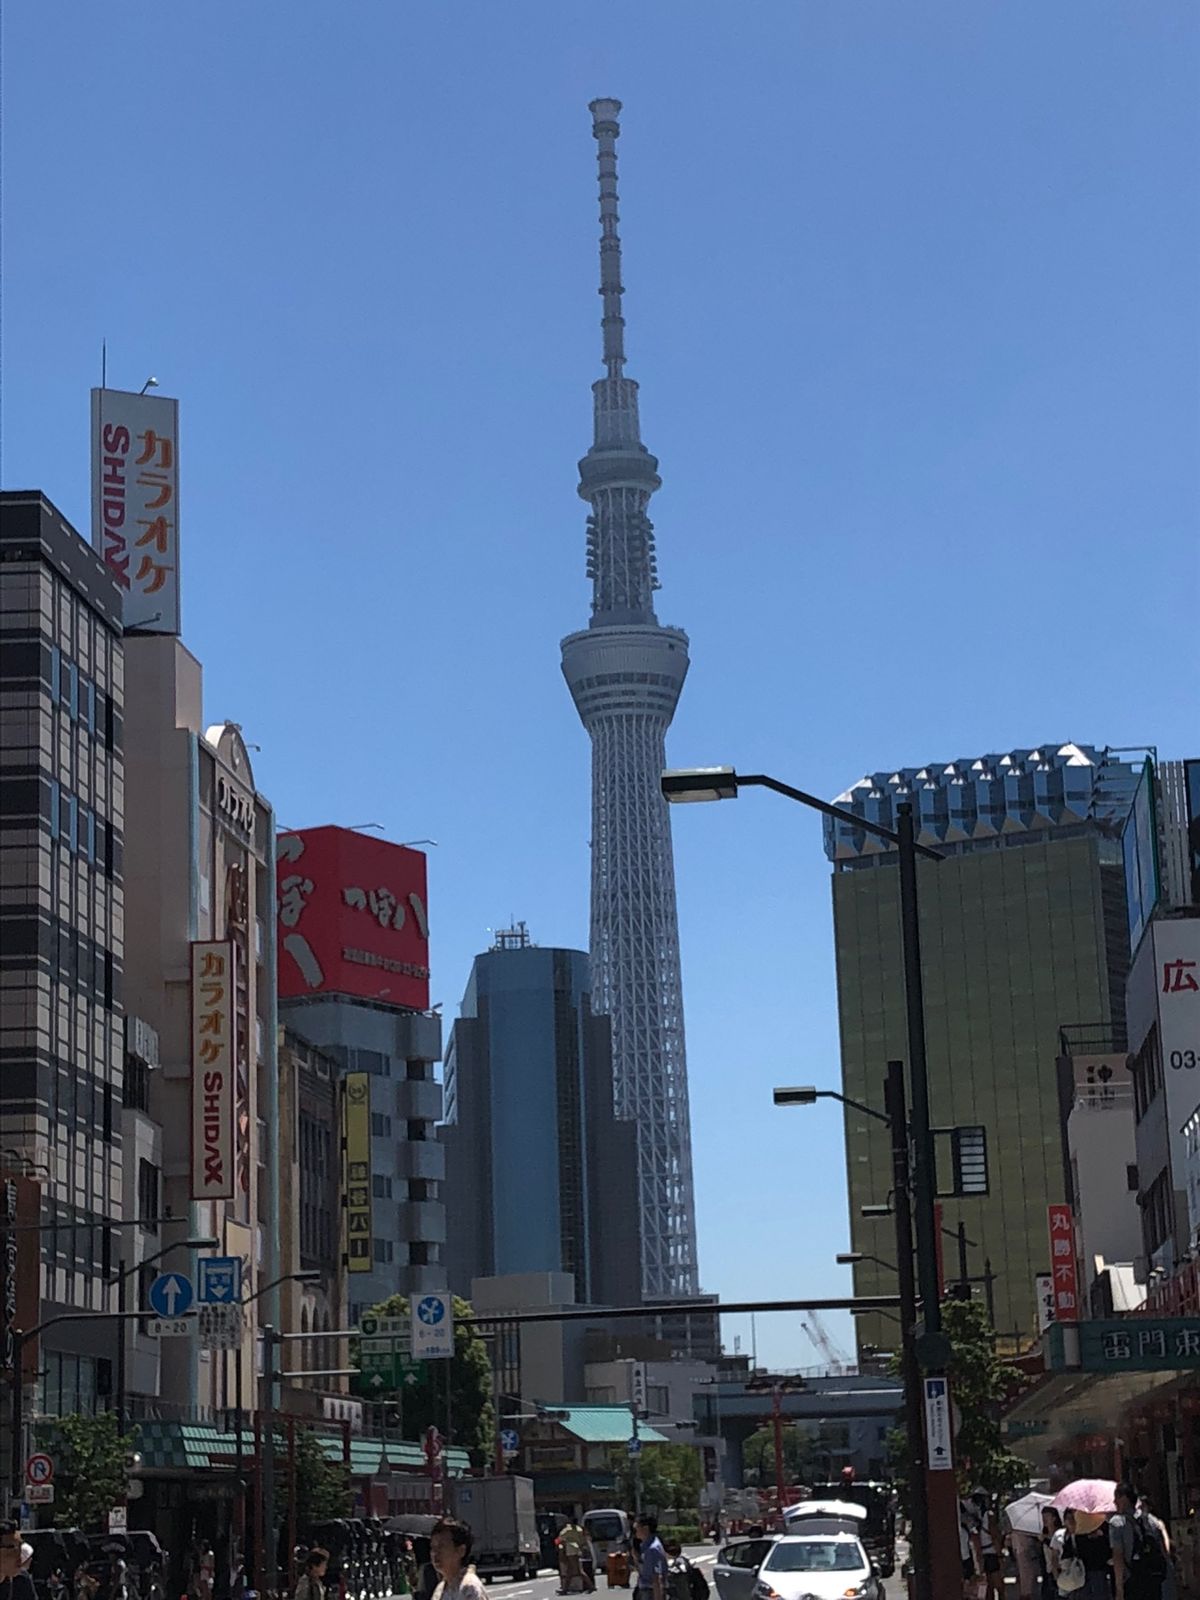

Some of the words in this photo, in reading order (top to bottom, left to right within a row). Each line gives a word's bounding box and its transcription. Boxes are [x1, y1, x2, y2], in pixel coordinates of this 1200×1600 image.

[103, 423, 131, 592] SHIDAX
[135, 429, 174, 594] カラオケ
[343, 887, 430, 939] つぼ八
[199, 952, 225, 1065] カラオケ
[204, 1071, 223, 1187] SHIDAX
[1104, 1330, 1200, 1360] 雷門東
